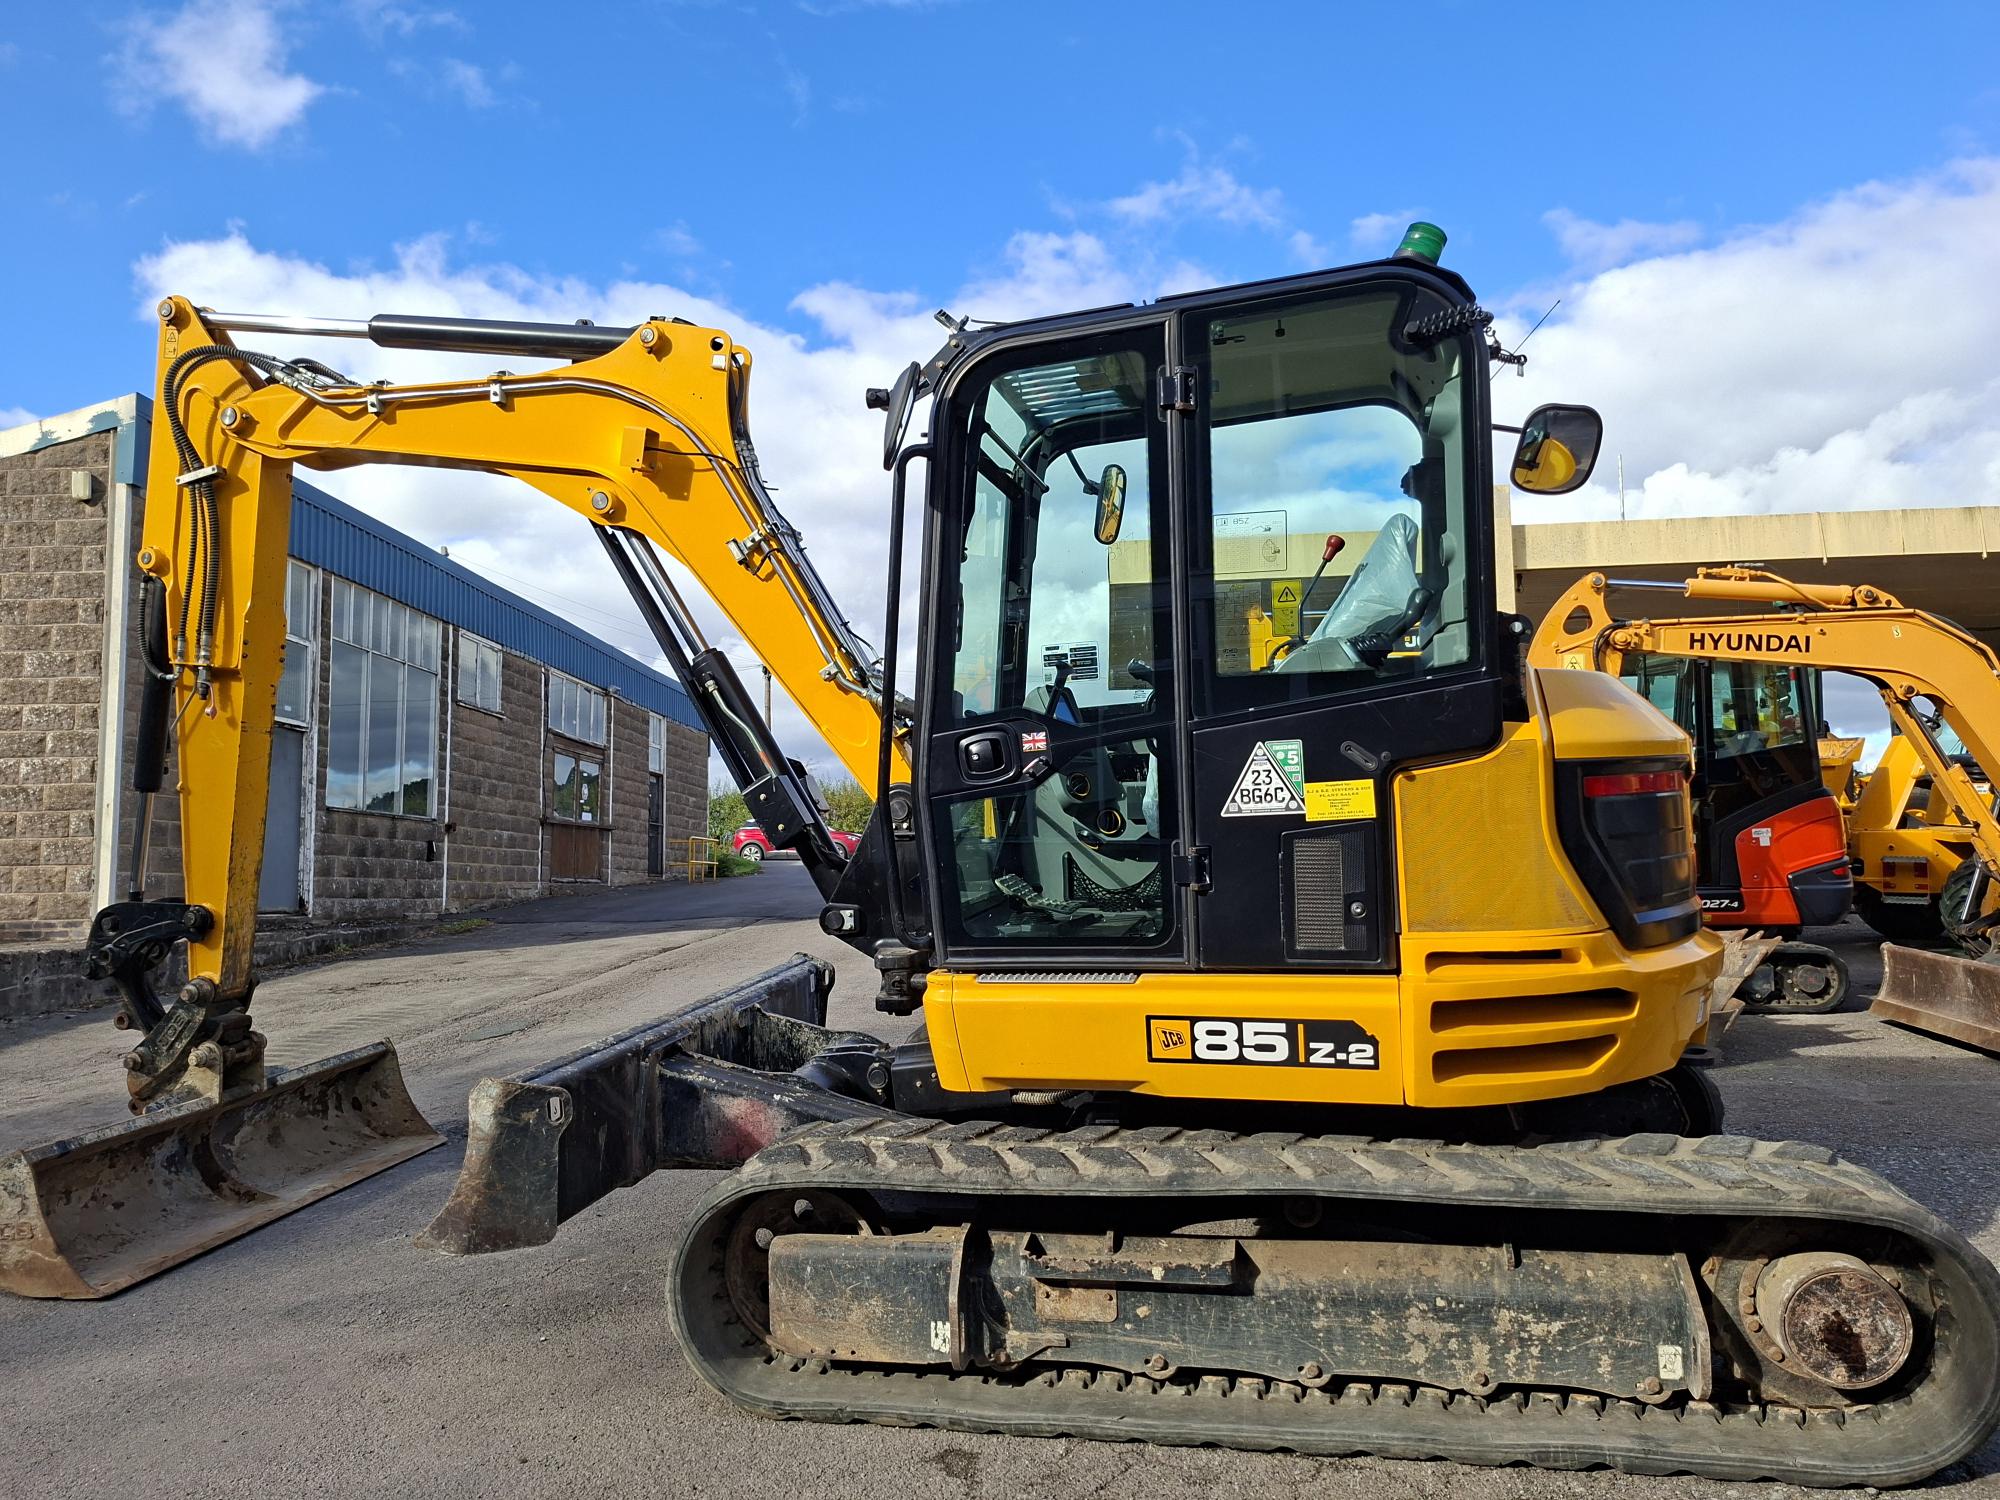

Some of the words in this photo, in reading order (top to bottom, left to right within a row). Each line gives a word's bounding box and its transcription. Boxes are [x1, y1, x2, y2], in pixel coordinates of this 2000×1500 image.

[1689, 632, 1811, 653] HYUNDAI
[1287, 750, 1299, 765] 5
[1251, 769, 1273, 786] 23
[1240, 787, 1286, 805] BG6C
[1161, 1029, 1185, 1050] JCB
[1193, 1020, 1289, 1062] 85
[1308, 1042, 1375, 1066] Z-2
